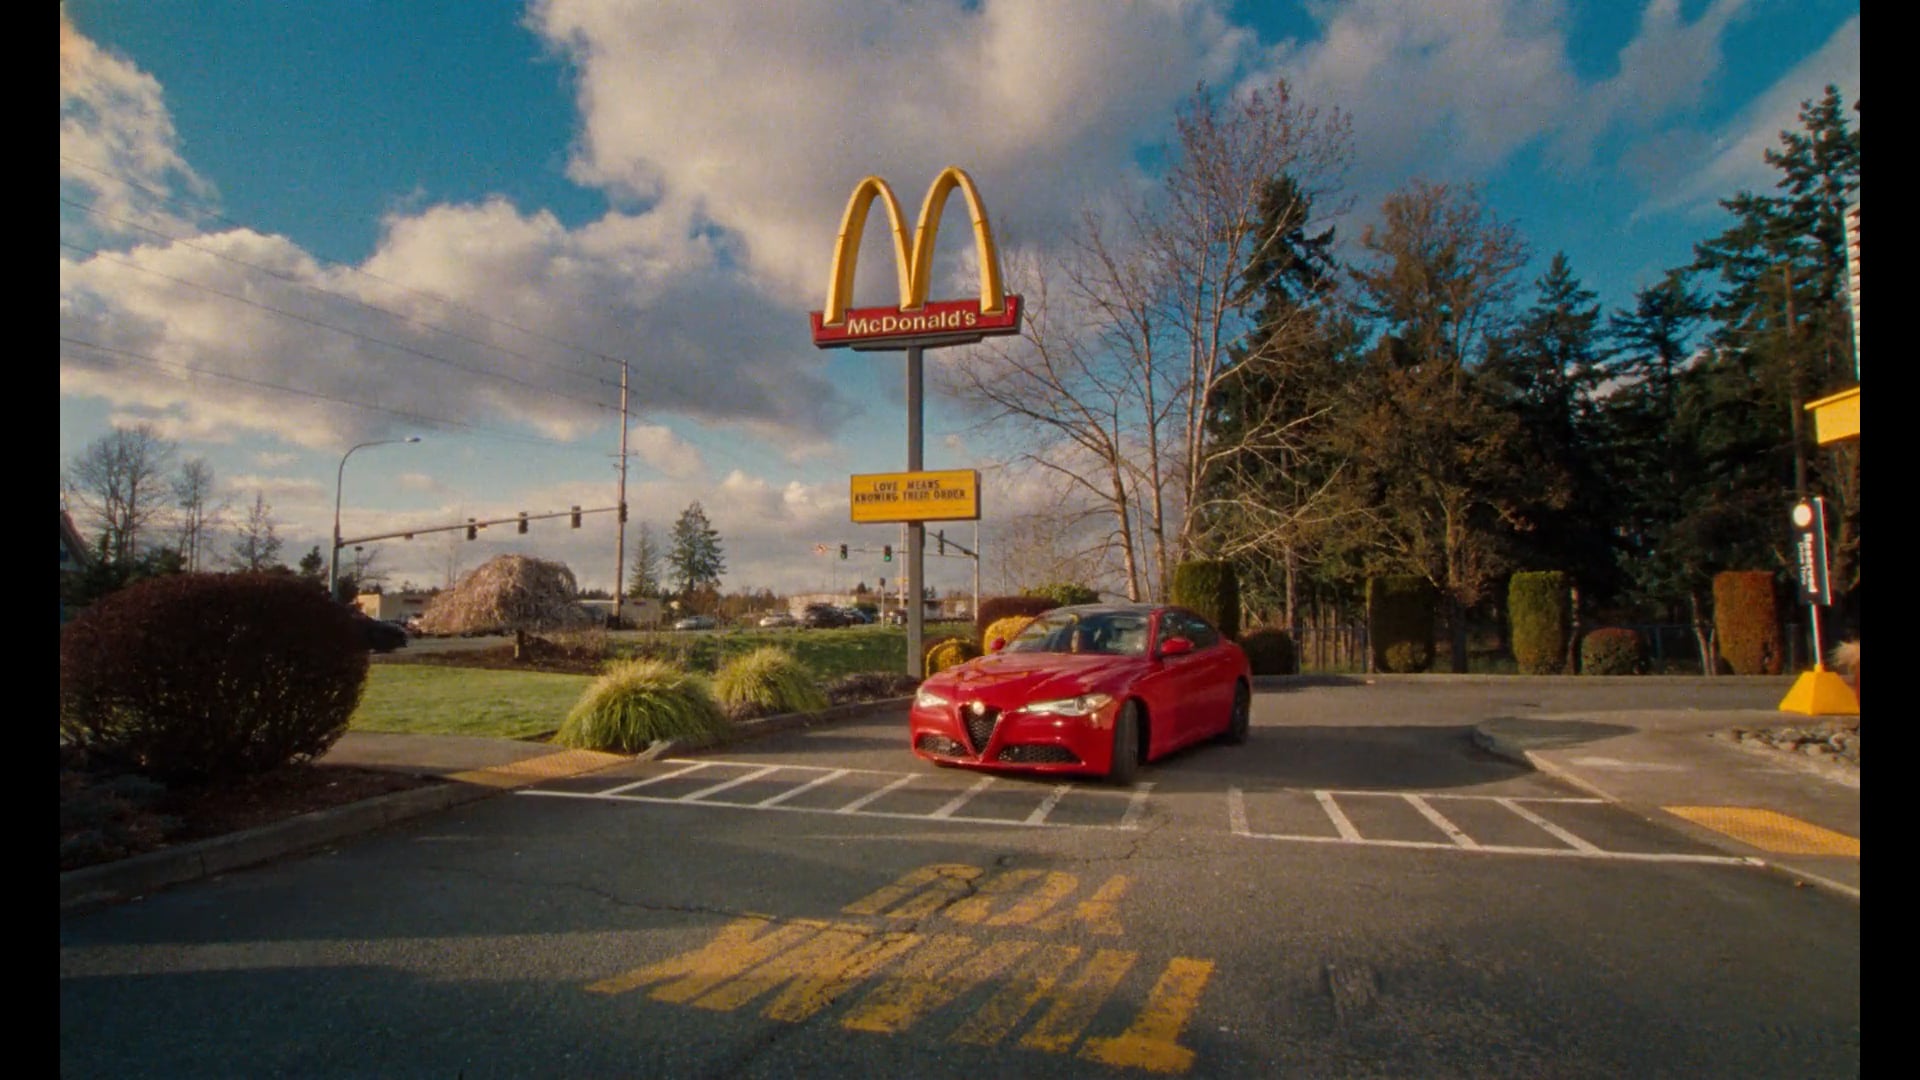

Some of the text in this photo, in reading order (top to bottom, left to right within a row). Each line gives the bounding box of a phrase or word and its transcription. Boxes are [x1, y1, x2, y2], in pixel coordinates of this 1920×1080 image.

[847, 309, 976, 335] McDonald's
[873, 479, 940, 491] LOVE MEANS
[855, 488, 965, 504] KNOWING THEIR ORDER
